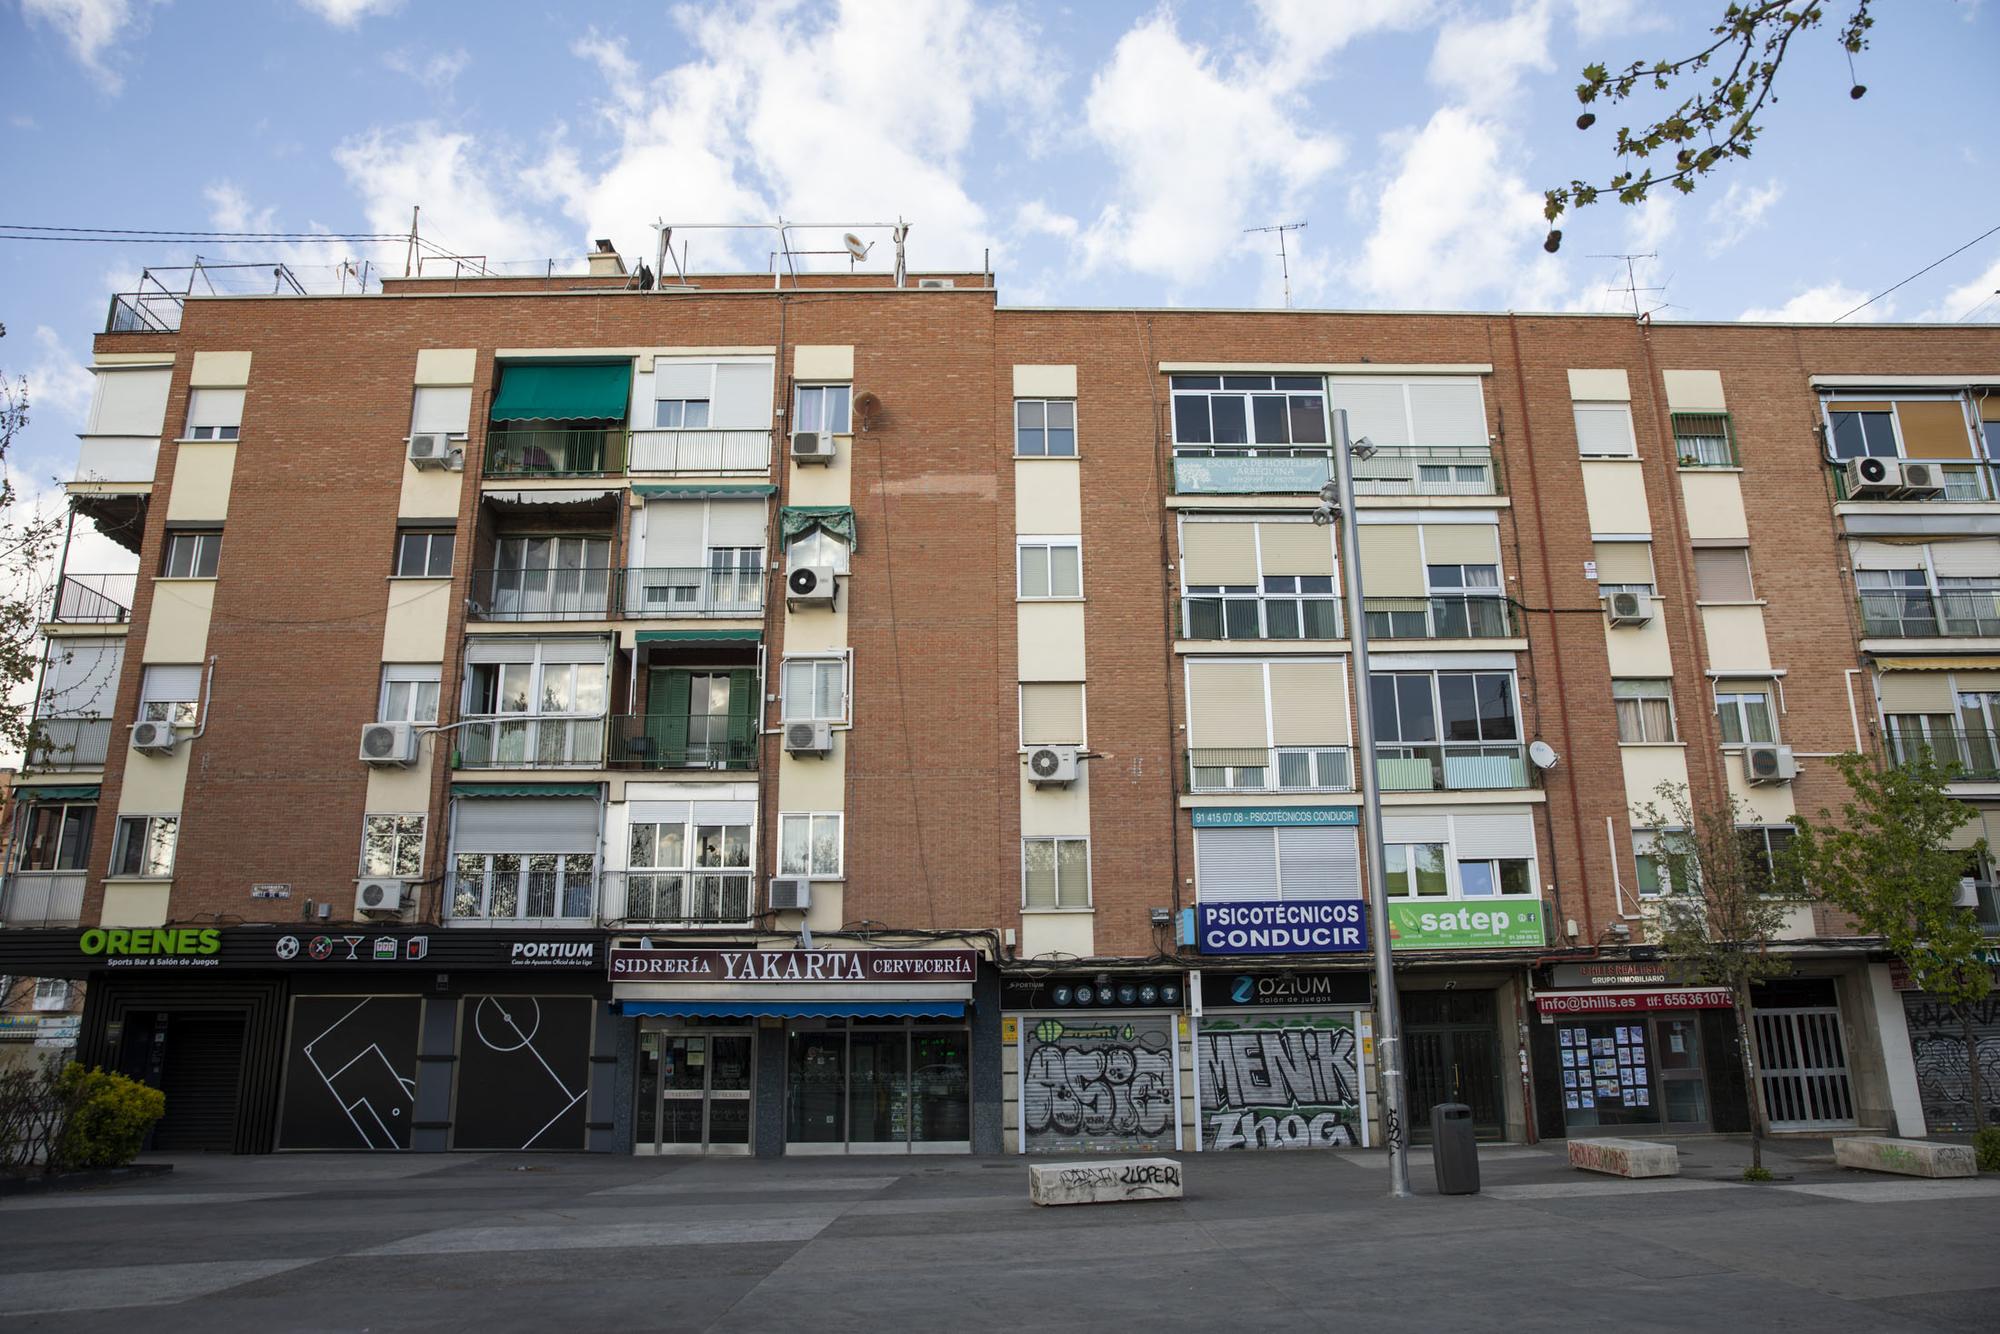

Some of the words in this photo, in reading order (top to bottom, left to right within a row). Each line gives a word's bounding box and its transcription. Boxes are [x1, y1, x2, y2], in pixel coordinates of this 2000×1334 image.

[1195, 812, 1205, 823] 91
[1207, 812, 1221, 822] 415
[1222, 812, 1232, 822] 07
[1233, 811, 1244, 822] 08
[1250, 809, 1312, 822] PSICOTÉCNICOS
[1313, 810, 1355, 821] CONDUCIR
[1206, 904, 1359, 926] PSICOTÉCNICOS
[1420, 907, 1510, 935] satep
[80, 928, 222, 955] ORENES
[1206, 927, 1361, 948] CONDUCIR
[511, 943, 593, 957] PORTIUM
[107, 958, 133, 967] Sports
[134, 958, 148, 966] Bar
[149, 958, 155, 966] &
[156, 957, 178, 966] Salón
[179, 957, 190, 966] de
[191, 958, 219, 967] Juegos
[614, 956, 712, 973] SIDRERÍA
[720, 953, 866, 980] YAKARTA
[872, 956, 972, 973] CERVECERÍA
[1592, 976, 1616, 984] GRUPO
[1616, 975, 1665, 983] INMOBILIARIO
[1286, 995, 1298, 1003] de
[1300, 995, 1331, 1004] juegos
[1540, 996, 1636, 1012] info@bhills.es
[1646, 997, 1662, 1007] tlf:
